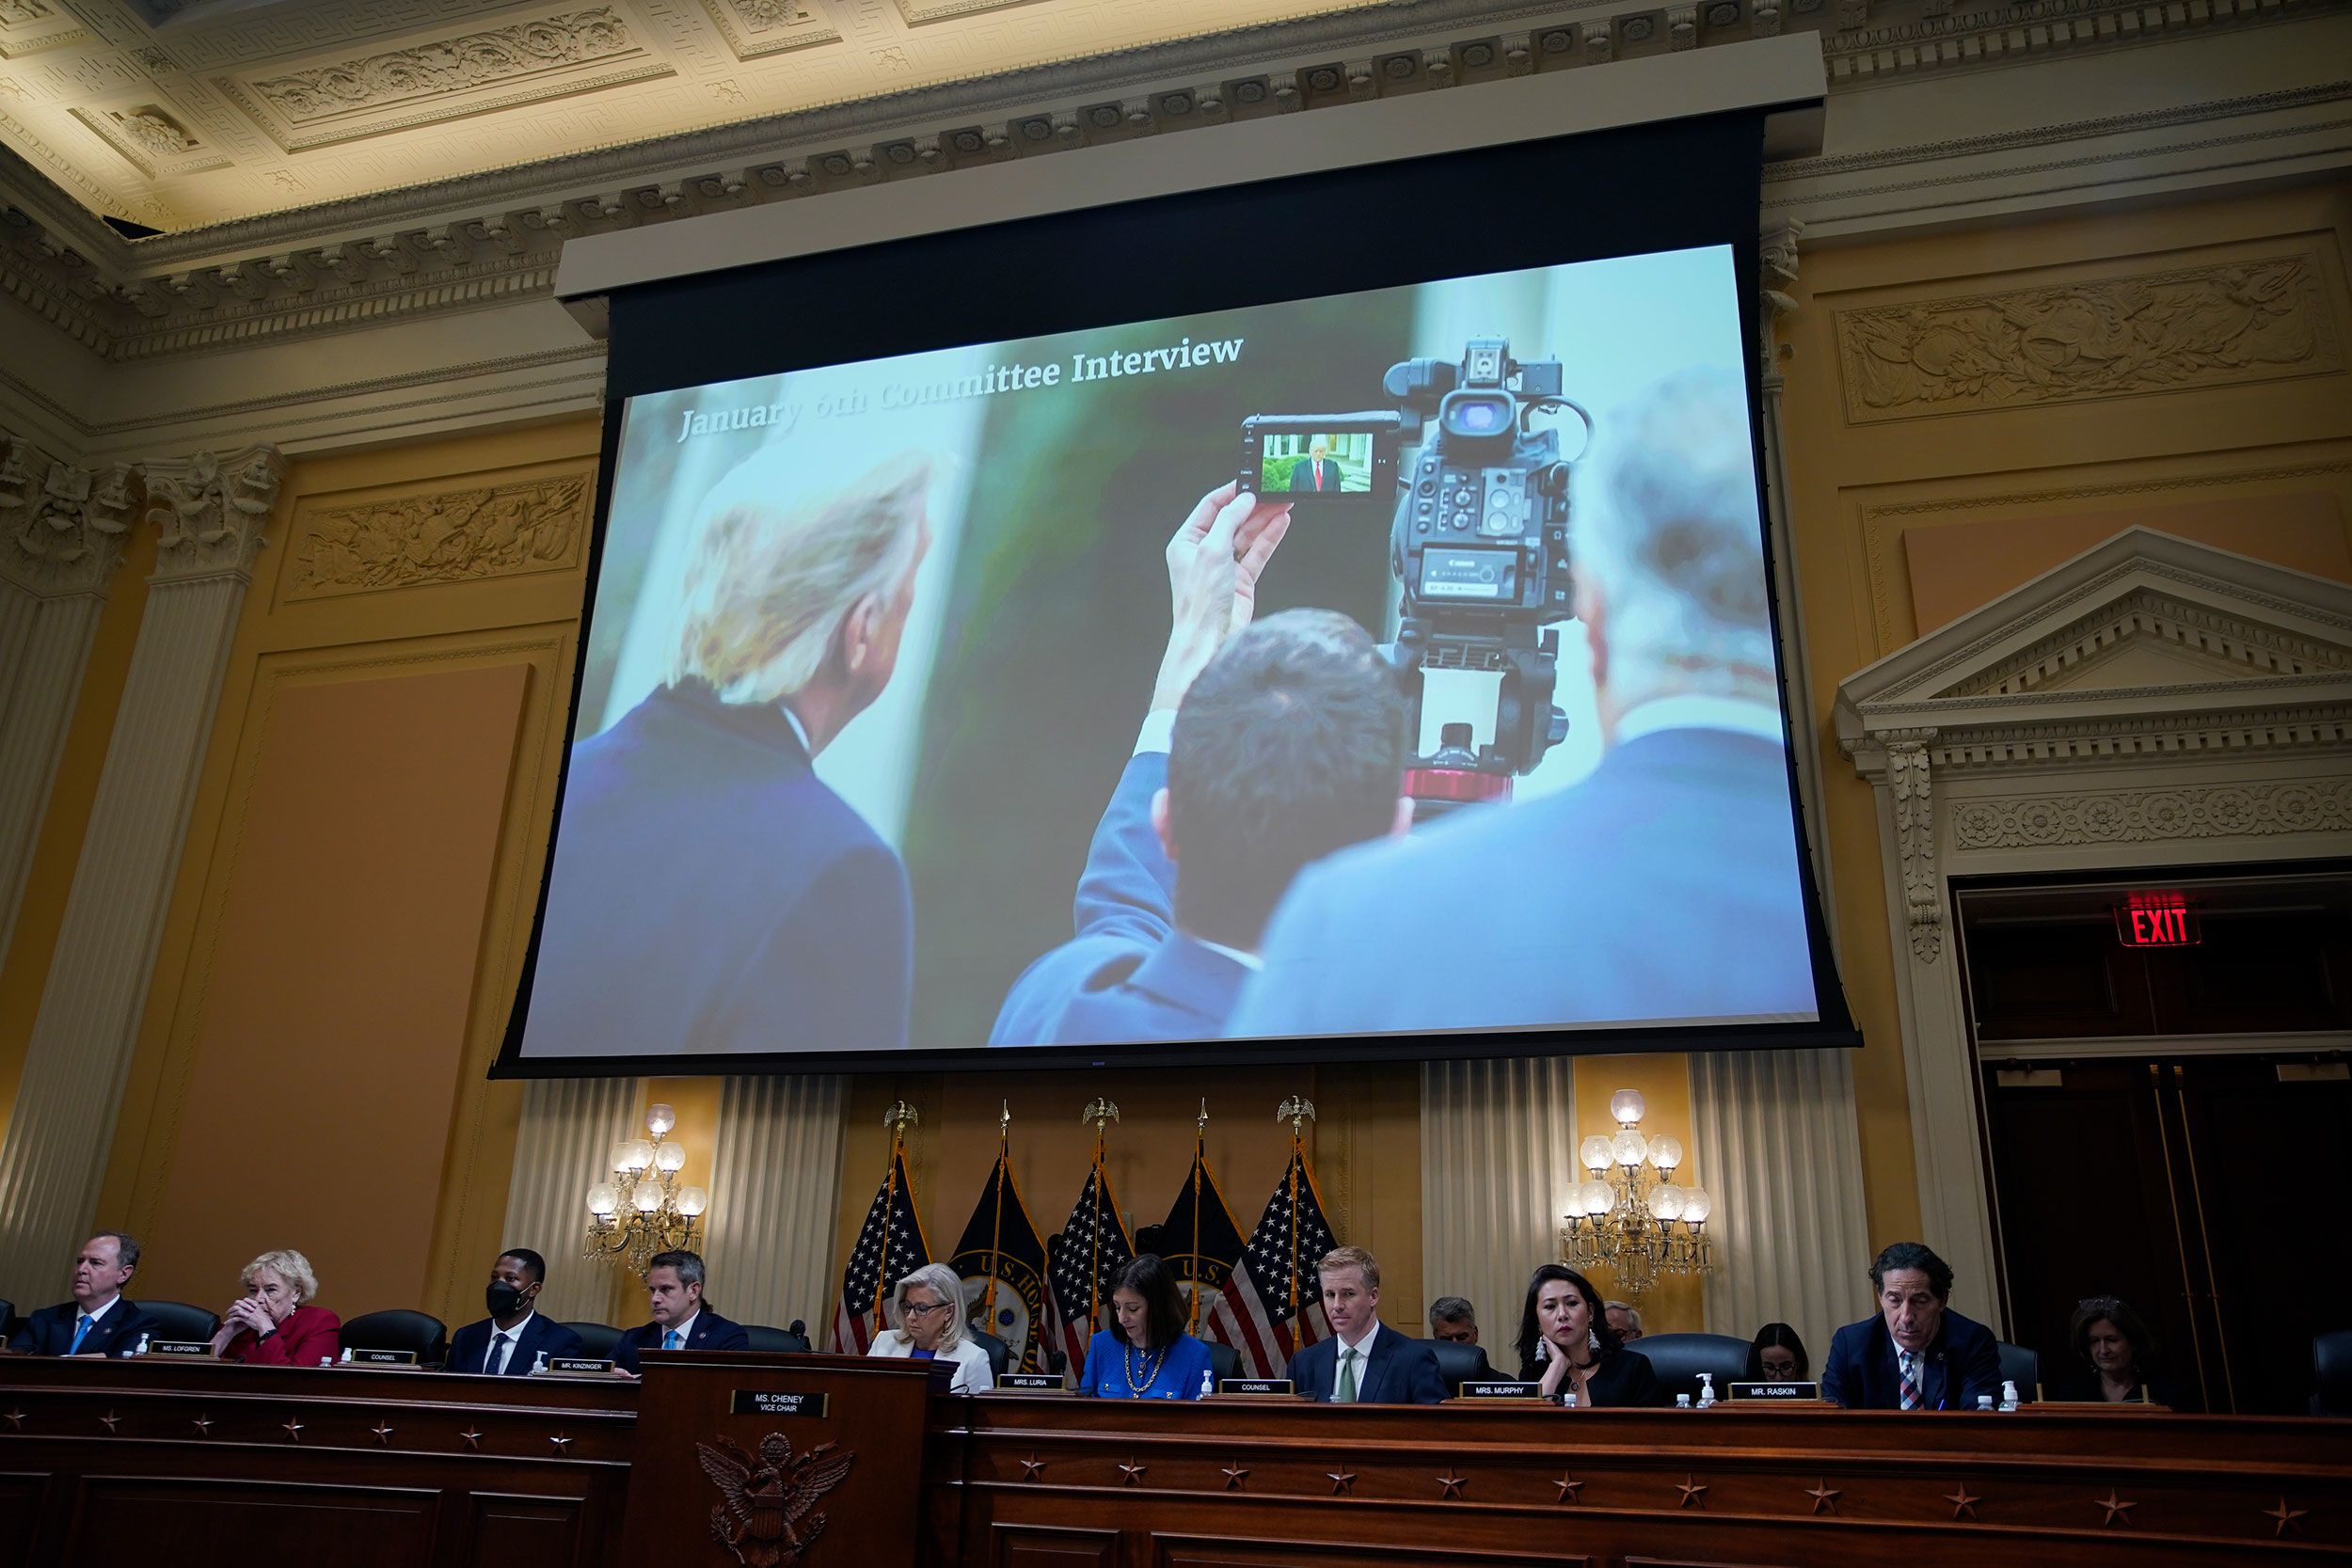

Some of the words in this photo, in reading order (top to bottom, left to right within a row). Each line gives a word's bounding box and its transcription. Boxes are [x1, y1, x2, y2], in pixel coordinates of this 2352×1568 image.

[677, 403, 803, 443] January
[815, 388, 868, 419] 6th
[880, 362, 1060, 410] Committee
[1072, 338, 1244, 383] Interview
[2131, 909, 2186, 942] EXIT
[1751, 1387, 1766, 1396] MR.
[1767, 1387, 1797, 1396] RASKIN
[755, 1394, 770, 1402] MS.
[771, 1394, 804, 1404] CHENEY
[760, 1403, 775, 1412] VICE
[776, 1404, 798, 1413] CHAIR
